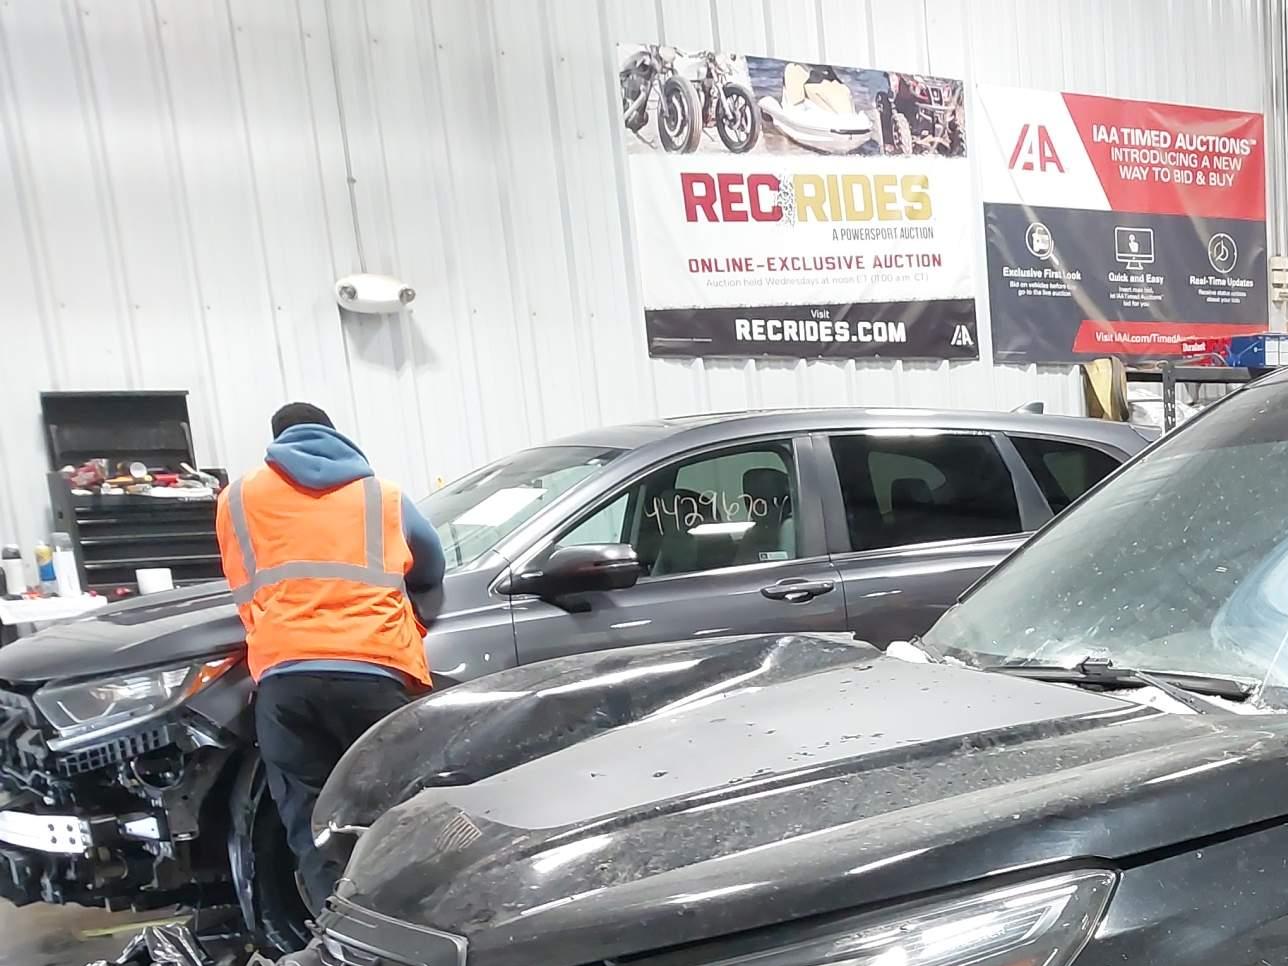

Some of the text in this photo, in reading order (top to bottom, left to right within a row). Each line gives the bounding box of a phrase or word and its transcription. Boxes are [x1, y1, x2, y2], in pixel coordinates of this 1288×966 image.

[1092, 124, 1119, 144] IAA
[1120, 127, 1171, 149] TIMED
[1111, 146, 1242, 172] INTRODUCING A NEW
[1119, 165, 1235, 187] WAY TO BID & BUY
[832, 226, 934, 241] A POWERSPORT AUCTION
[688, 253, 942, 273] ONLINE-EXCLUSIVE AUCTION
[1003, 266, 1042, 279] Exclusive
[1108, 272, 1164, 285] Quick and Easy
[1190, 275, 1254, 288] Real-Time Updates
[810, 308, 830, 320] Visit
[735, 318, 907, 343] RECRIDES.COM
[1095, 331, 1113, 342] Visit
